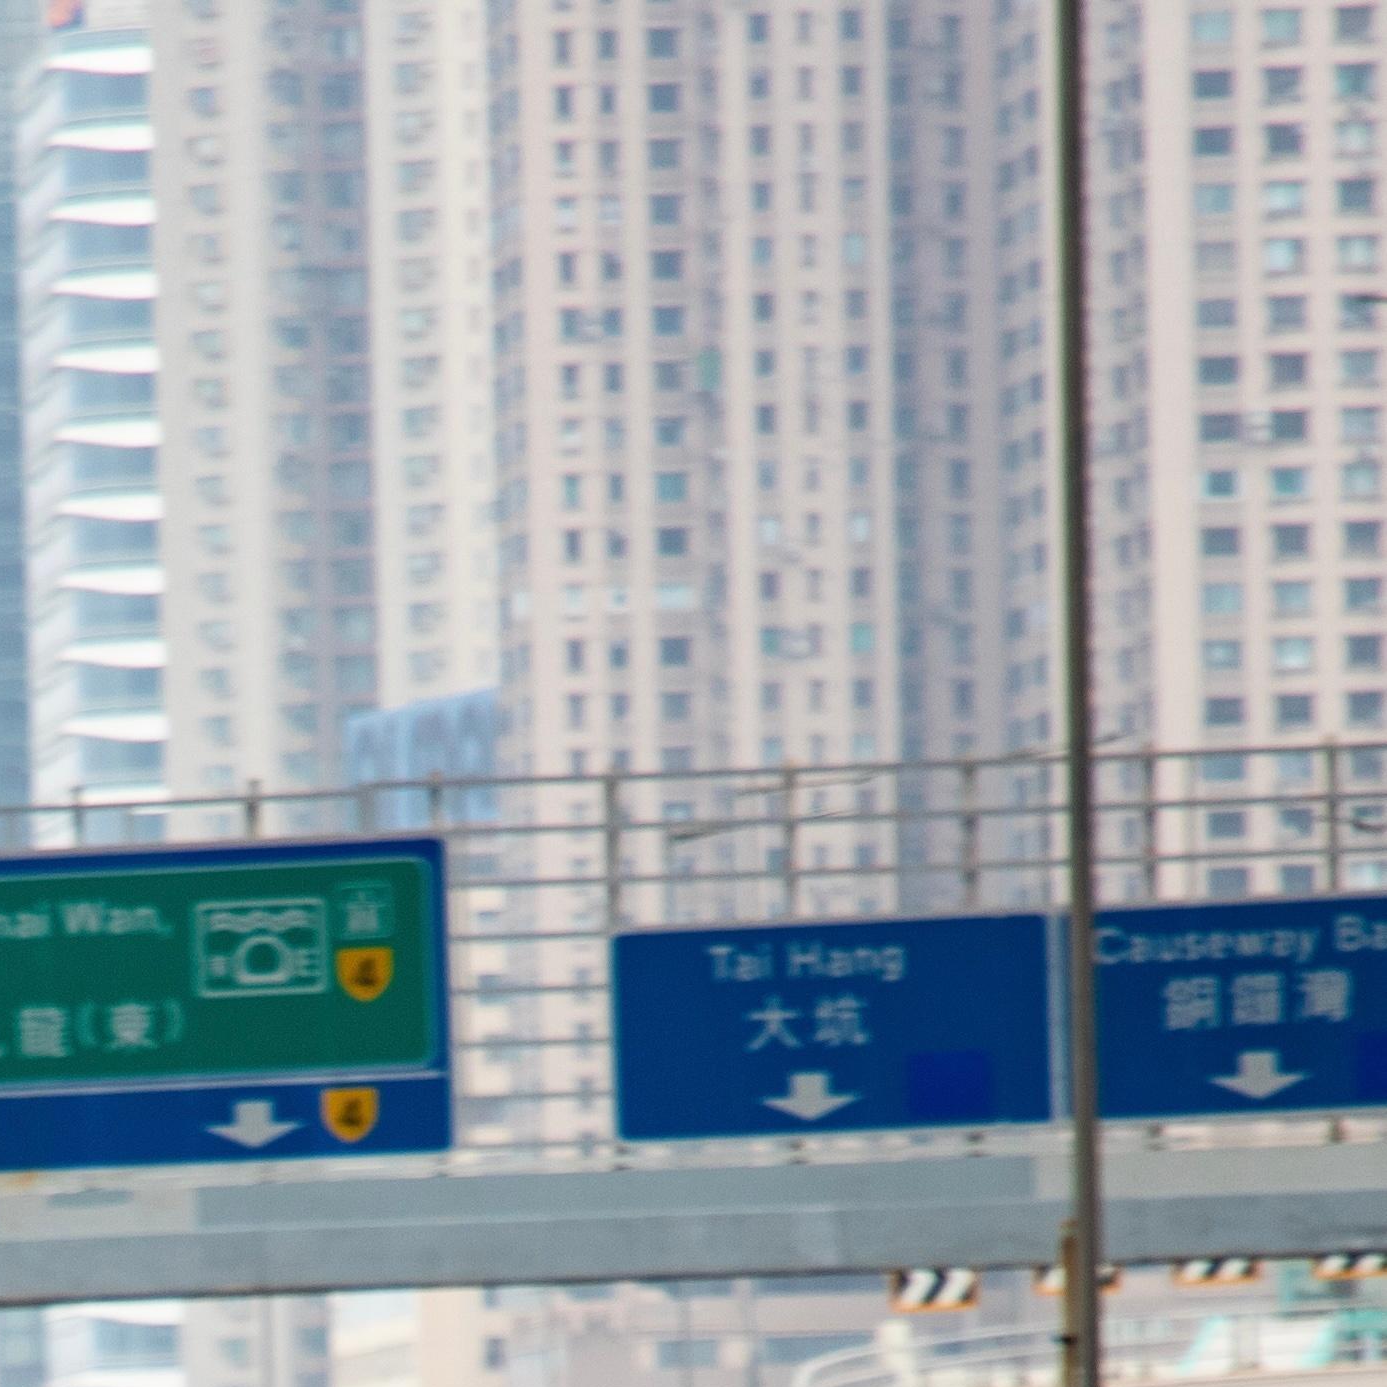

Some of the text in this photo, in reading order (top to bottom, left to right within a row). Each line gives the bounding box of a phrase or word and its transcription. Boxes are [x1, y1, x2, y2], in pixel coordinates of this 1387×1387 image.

[708, 942, 905, 983] Tai Hang
[1095, 915, 1387, 963] Causeway Ba
[745, 994, 871, 1051] 大坑
